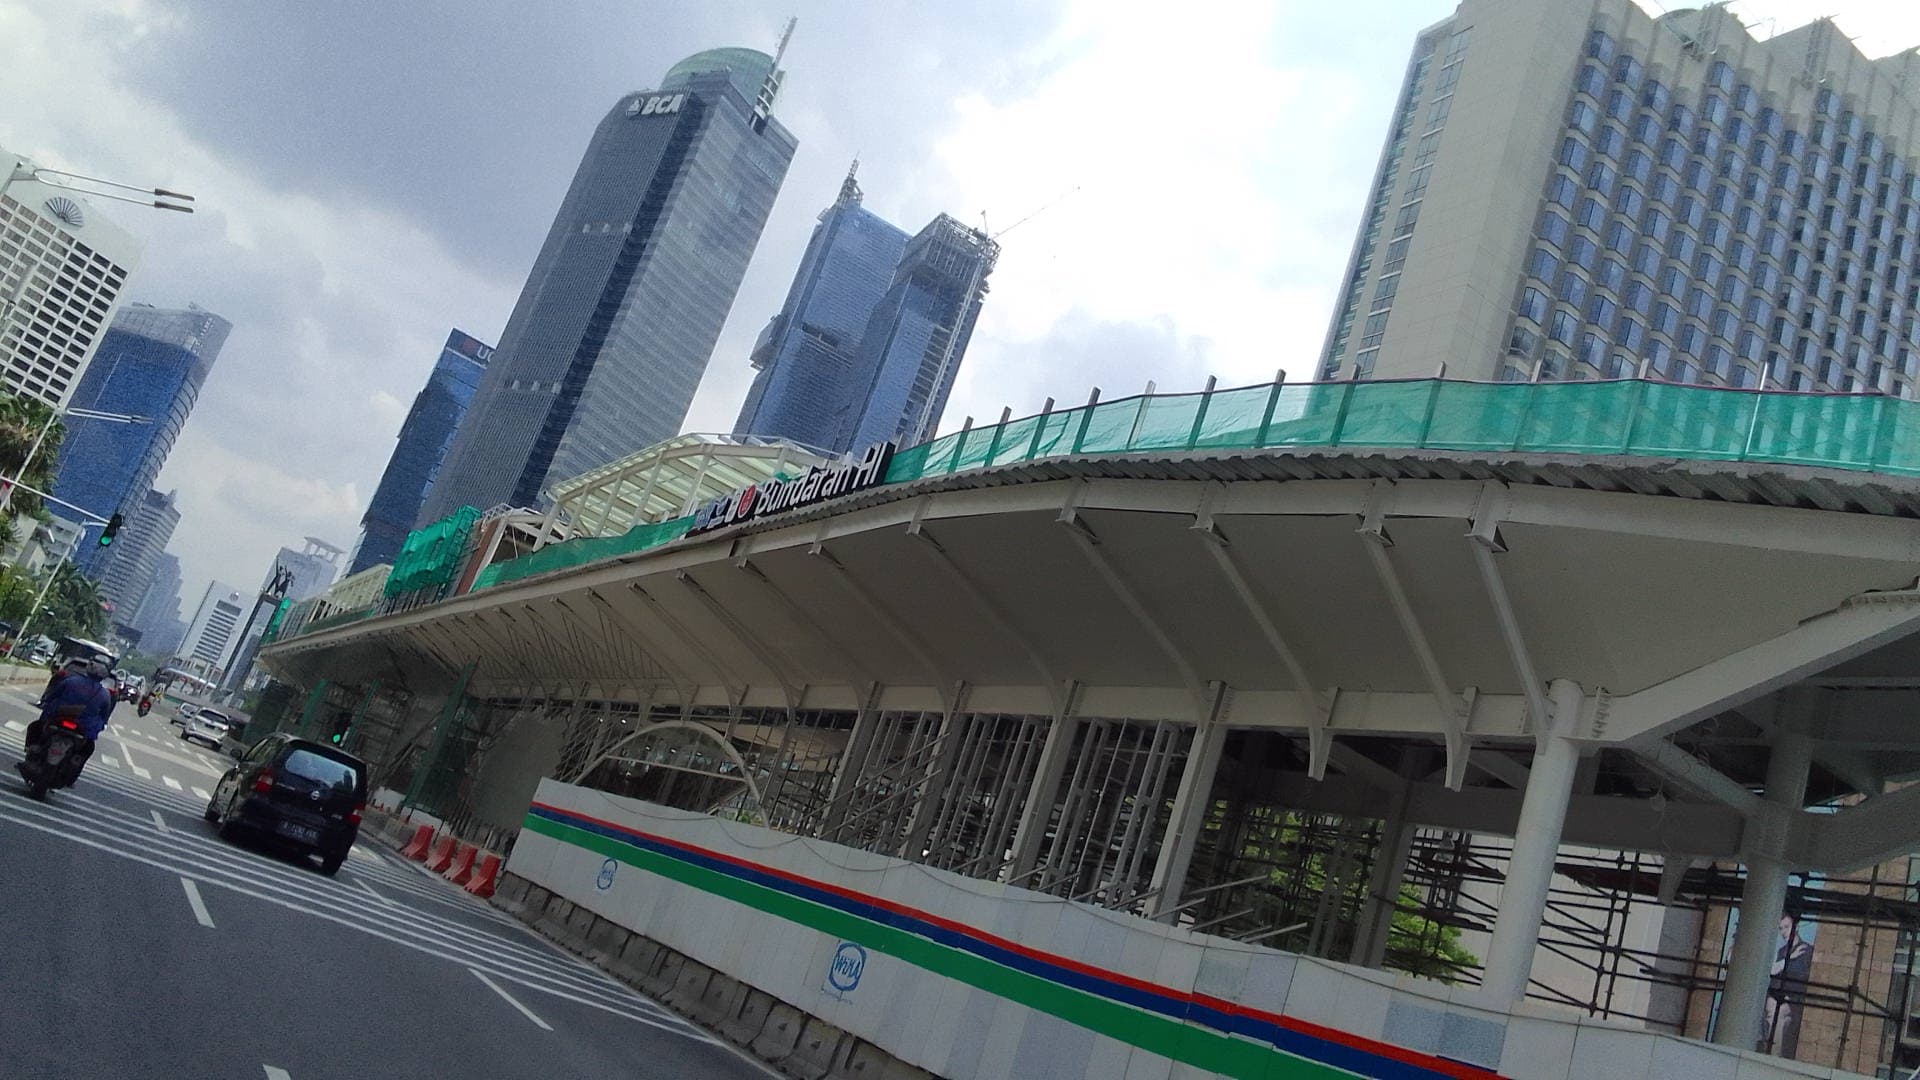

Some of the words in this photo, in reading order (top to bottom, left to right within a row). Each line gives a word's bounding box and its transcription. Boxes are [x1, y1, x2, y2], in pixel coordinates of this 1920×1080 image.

[641, 94, 684, 115] BCA
[754, 463, 851, 515] Bundaran
[851, 440, 888, 489] HI
